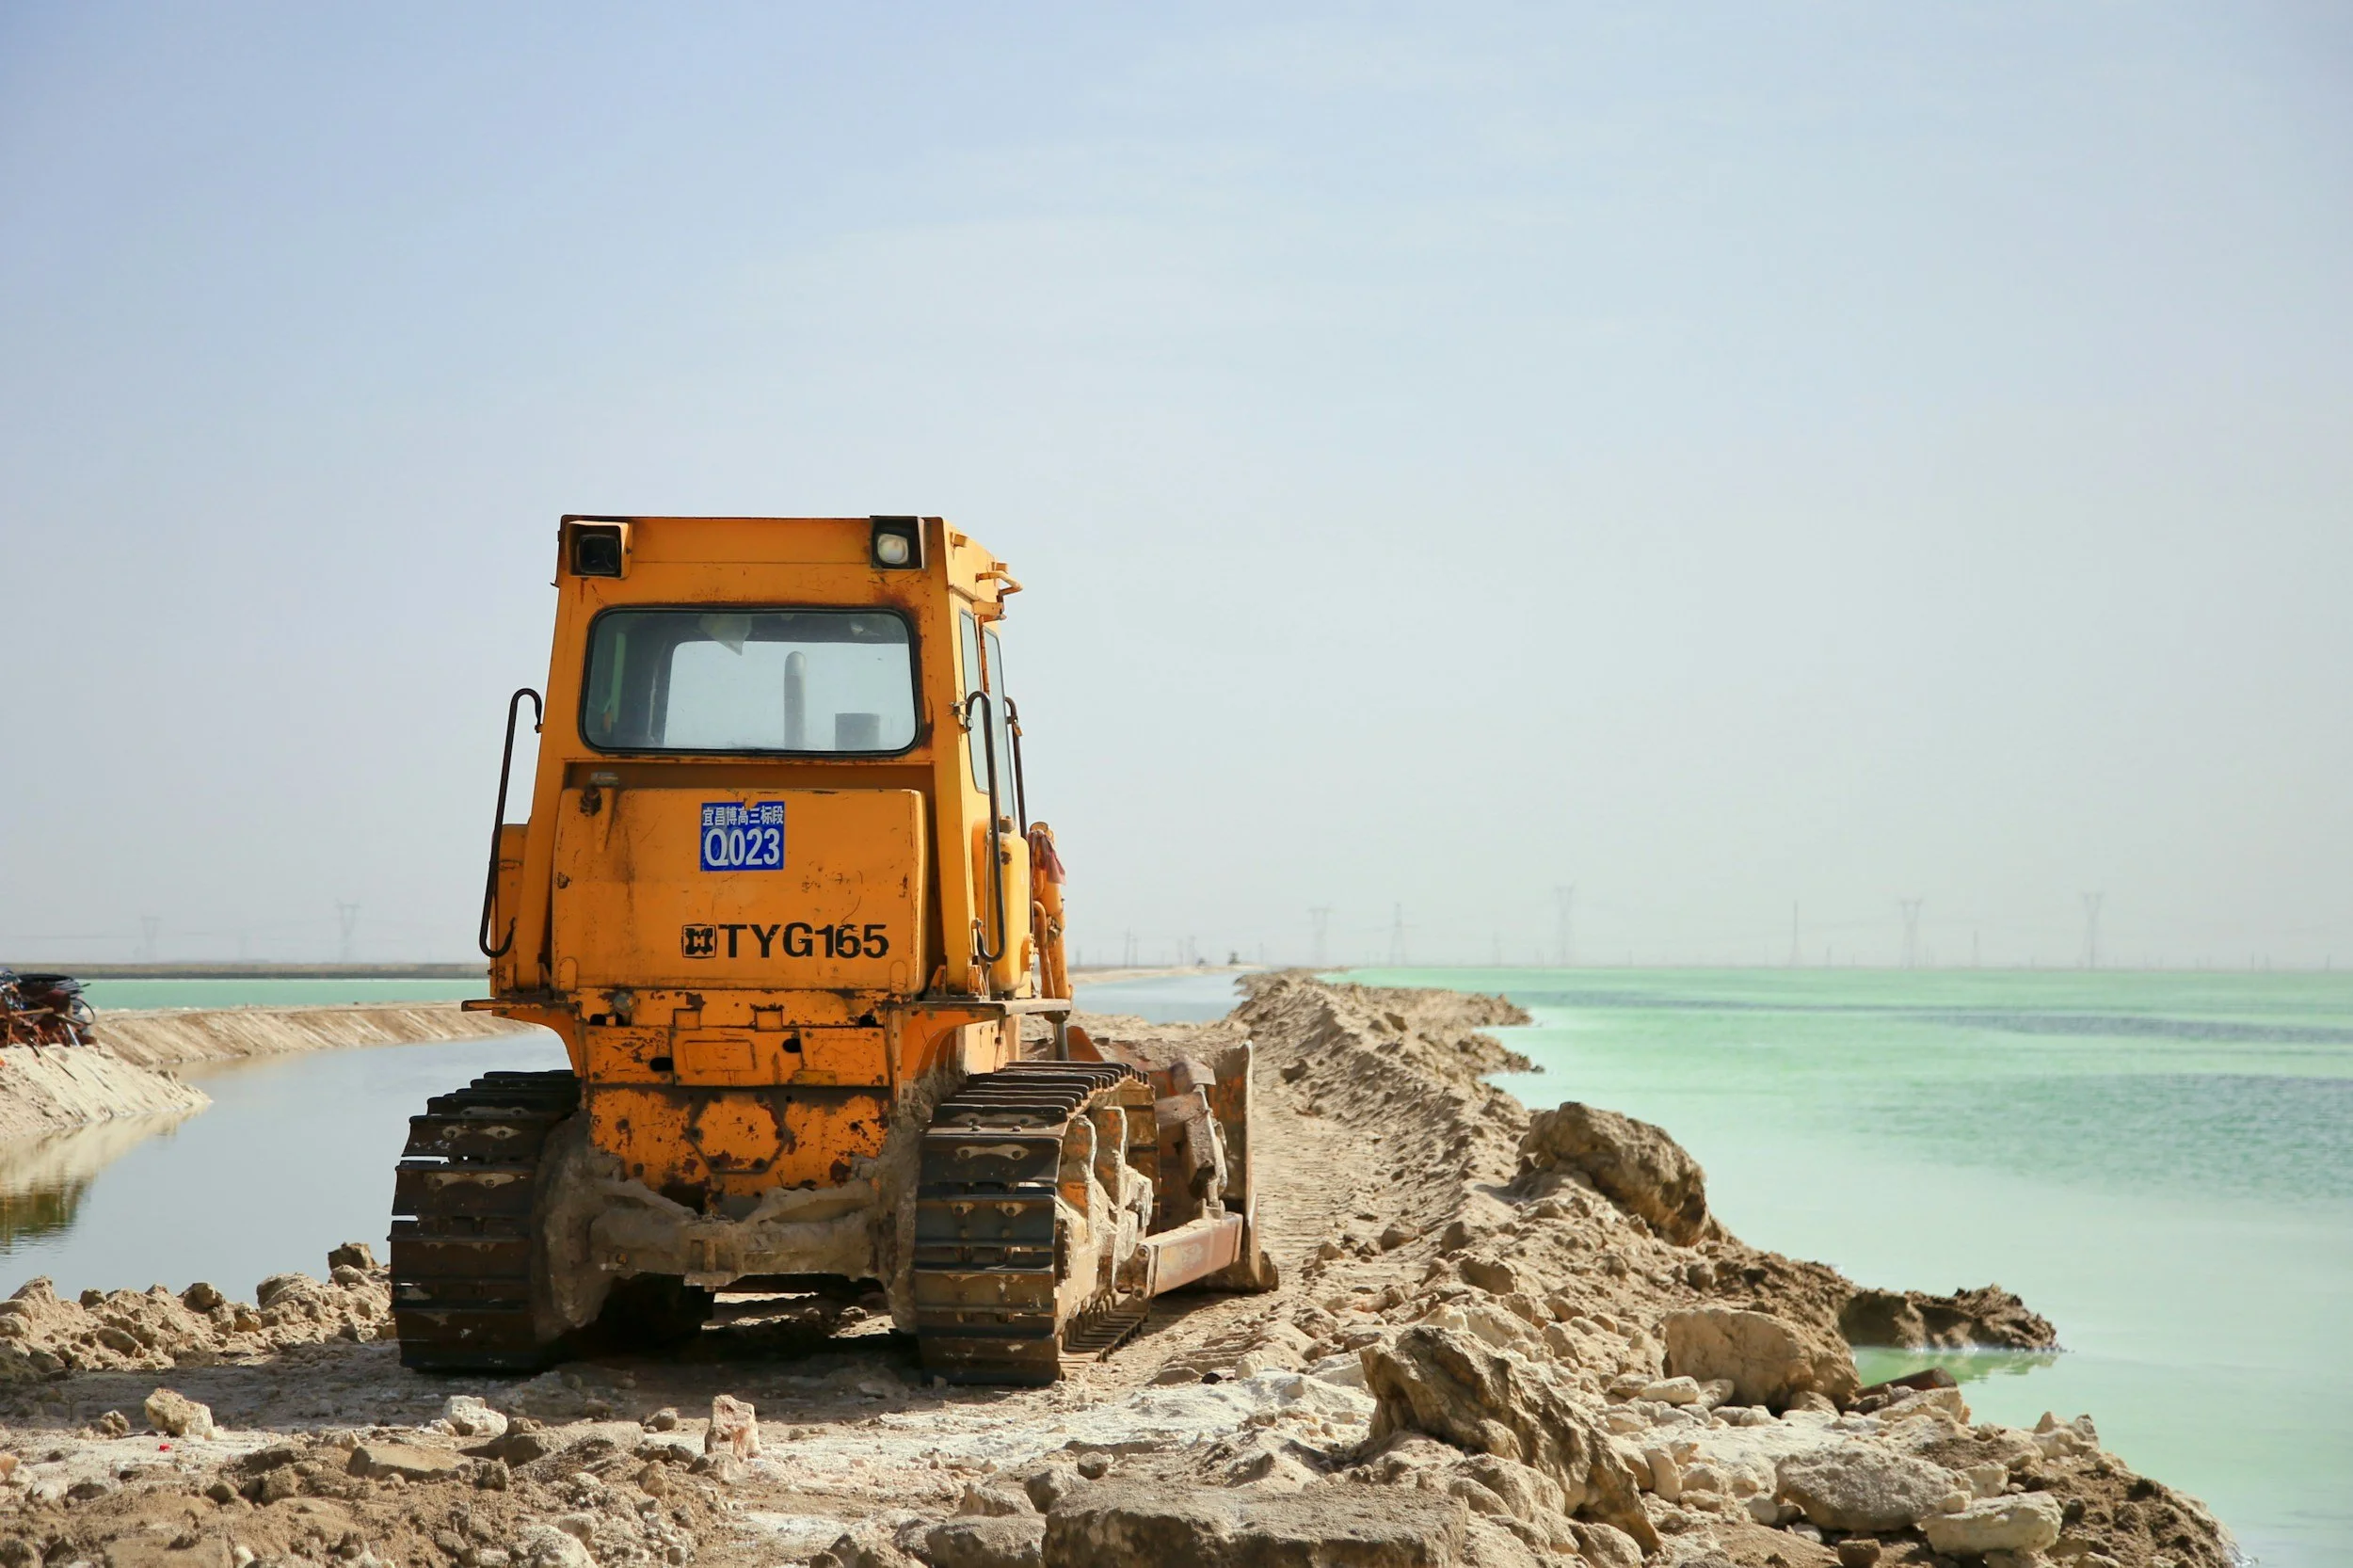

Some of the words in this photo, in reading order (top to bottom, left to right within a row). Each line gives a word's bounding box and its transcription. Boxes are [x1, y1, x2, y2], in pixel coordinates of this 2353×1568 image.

[702, 805, 784, 826] 宜昌博高三标段
[704, 827, 780, 867] Q023
[717, 921, 889, 959] TYG165
